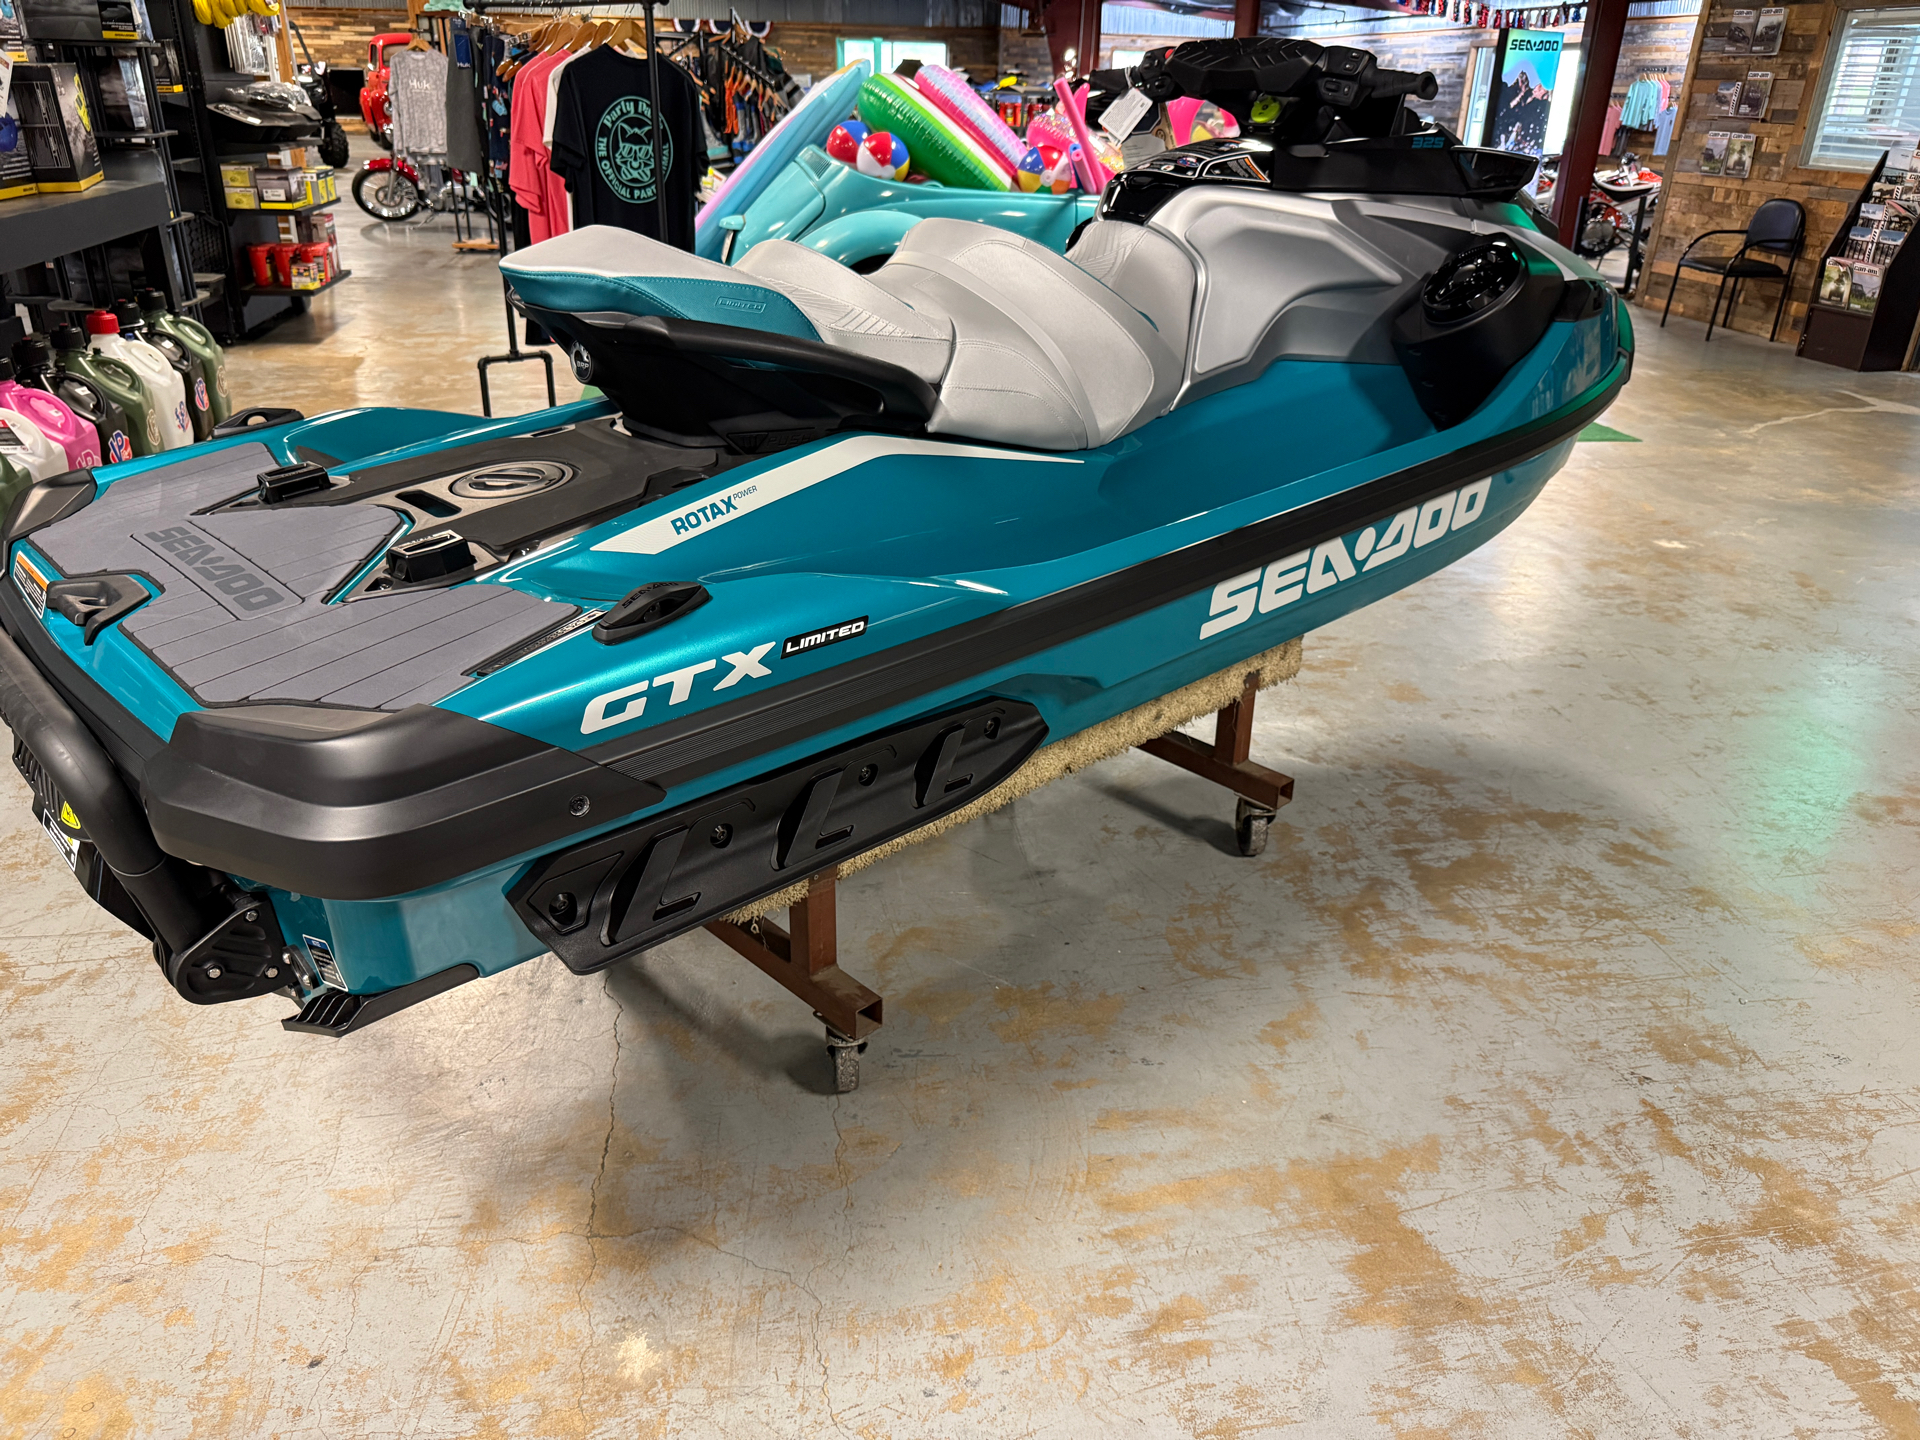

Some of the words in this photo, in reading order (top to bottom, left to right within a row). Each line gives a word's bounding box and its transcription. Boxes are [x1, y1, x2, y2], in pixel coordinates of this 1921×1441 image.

[409, 78, 431, 90] Huk
[602, 100, 635, 129] Party
[597, 136, 608, 158] THE
[1411, 137, 1445, 149] 325
[600, 160, 632, 199] OFFICIAL
[633, 184, 658, 200] PART
[1854, 265, 1878, 275] can-am
[576, 360, 590, 370] BRP
[670, 495, 738, 535] ROTAX
[732, 485, 758, 501] POWER
[580, 641, 777, 735] GTX
[785, 620, 865, 654] LIMITED
